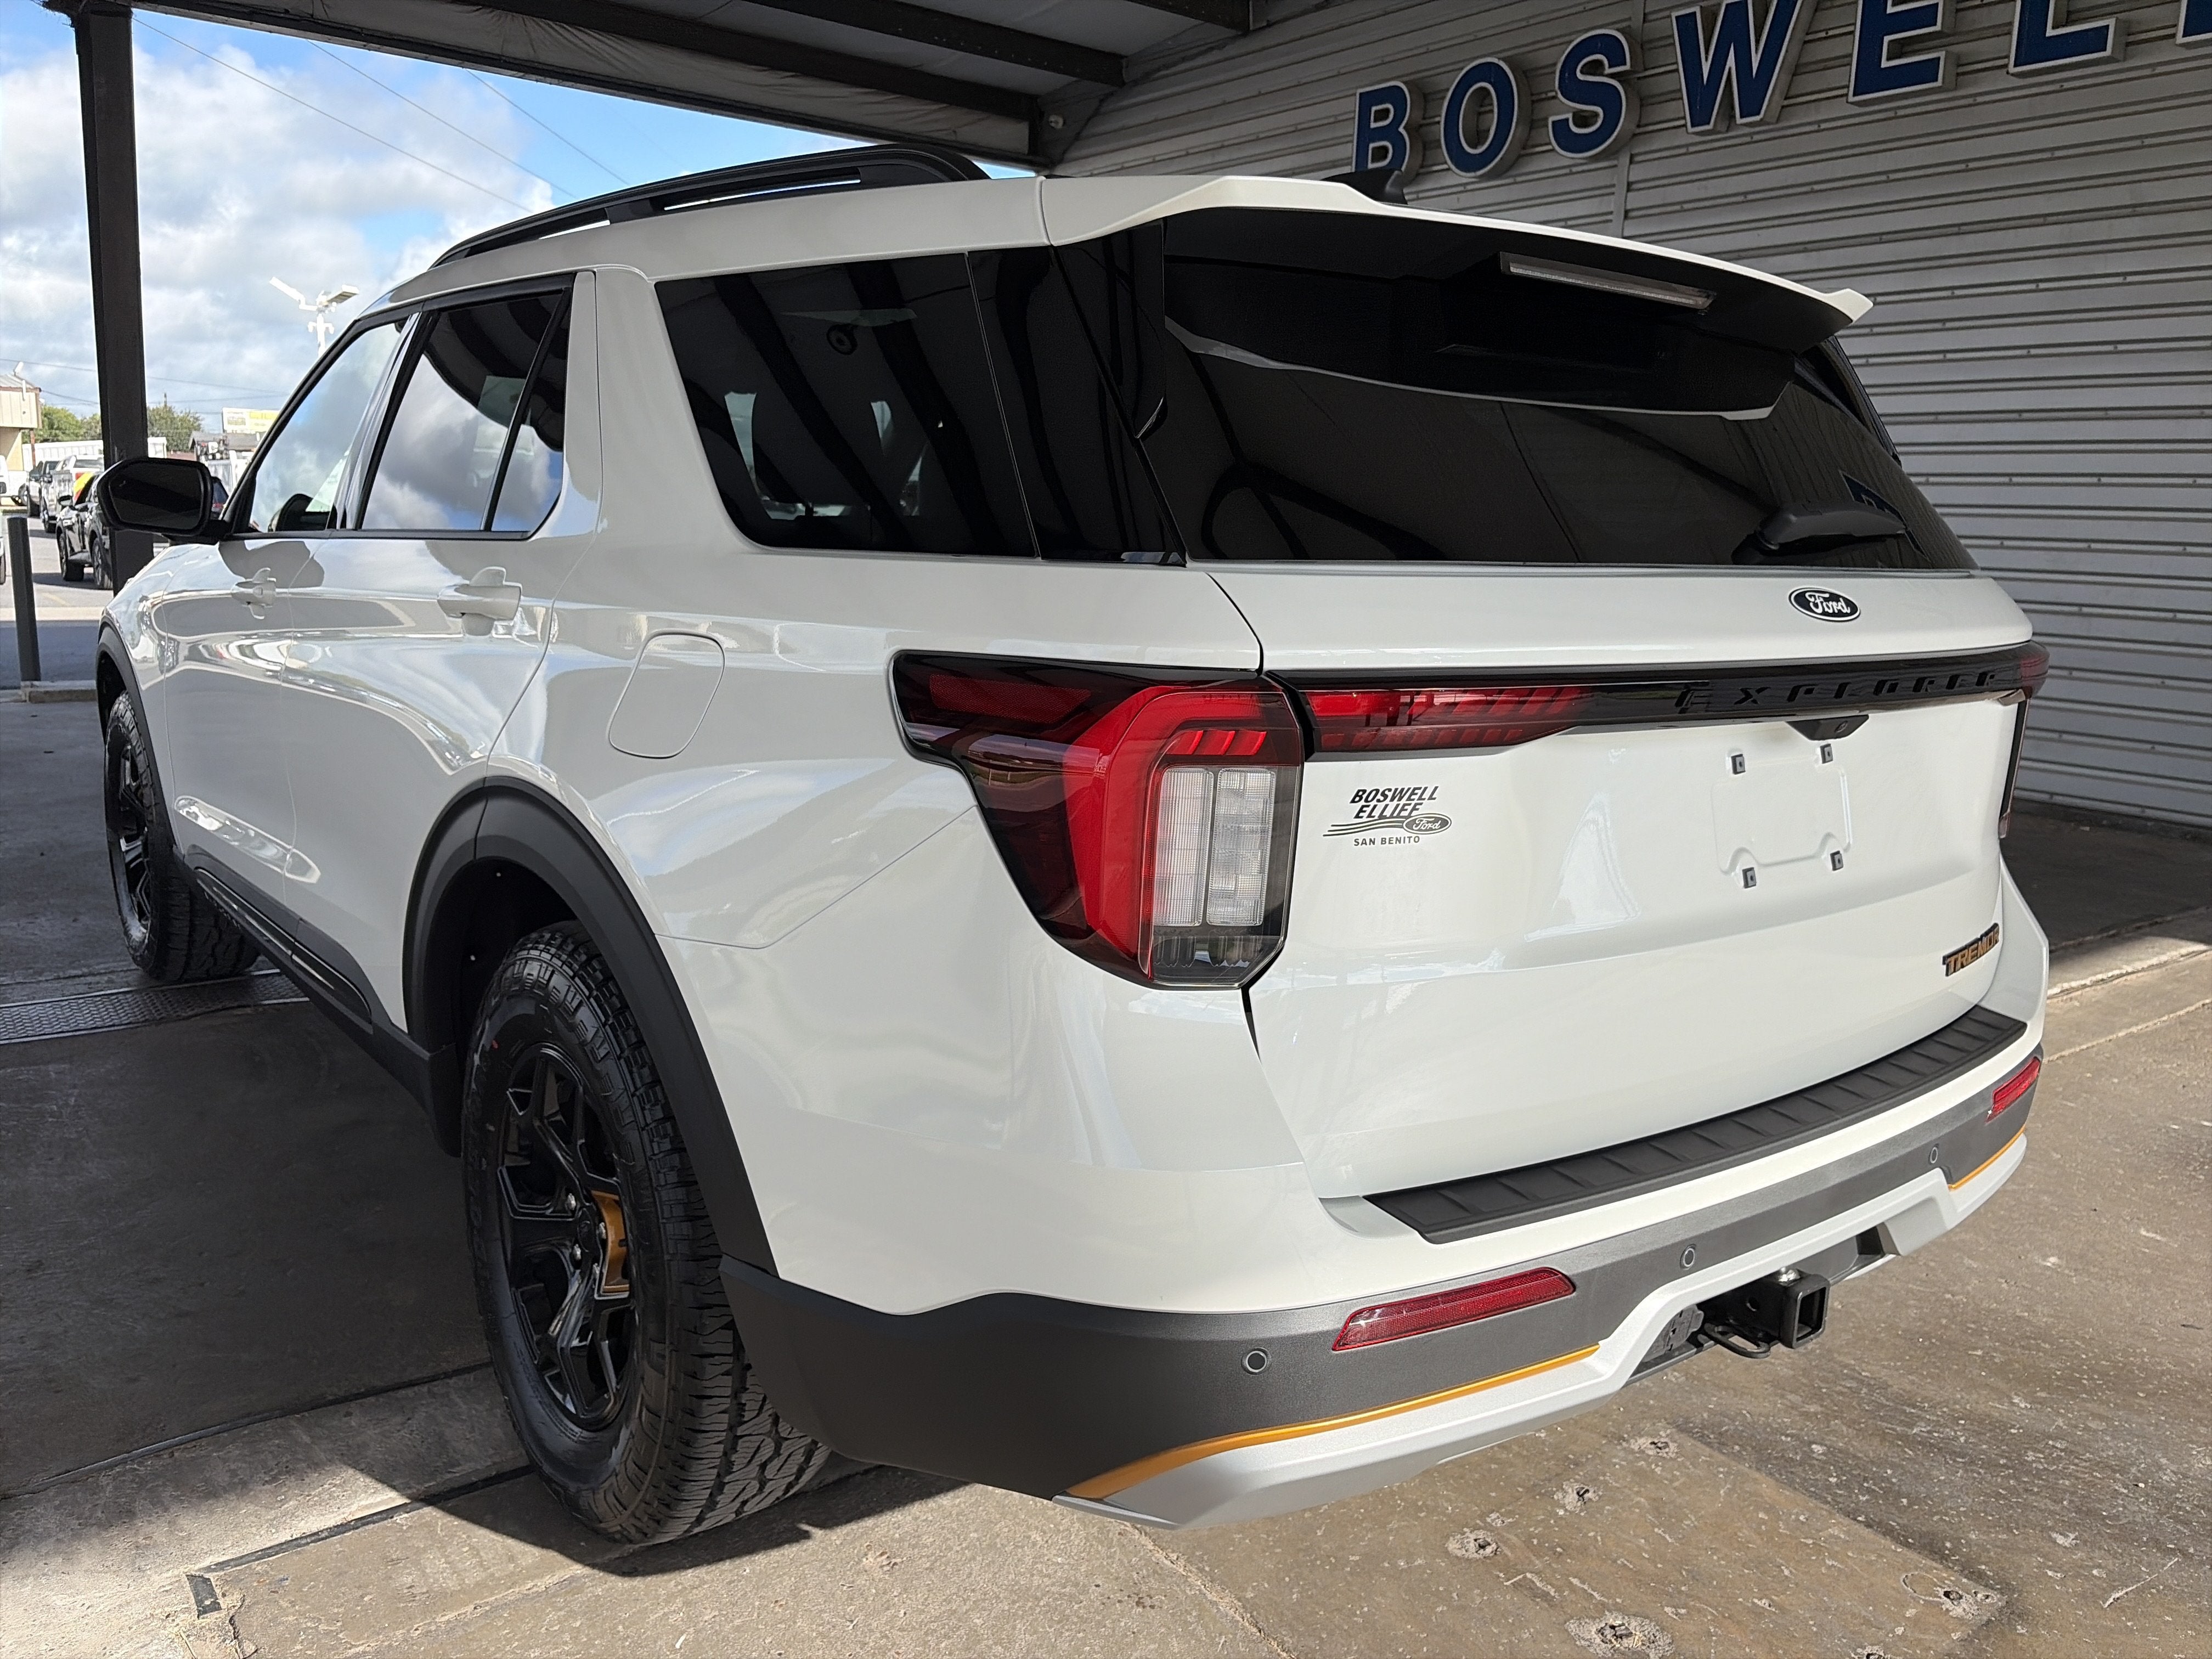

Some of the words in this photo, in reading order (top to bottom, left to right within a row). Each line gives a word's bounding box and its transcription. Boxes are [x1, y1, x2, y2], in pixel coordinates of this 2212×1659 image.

[1352, 0, 2212, 177] BOSWEL
[1805, 592, 1850, 614] Ford
[1350, 786, 1438, 804] BOSWELL
[1353, 802, 1424, 819] ELLIFF
[1413, 817, 1441, 830] Ford
[1380, 836, 1420, 845] BENITO
[1942, 922, 2000, 977] TREMOR
